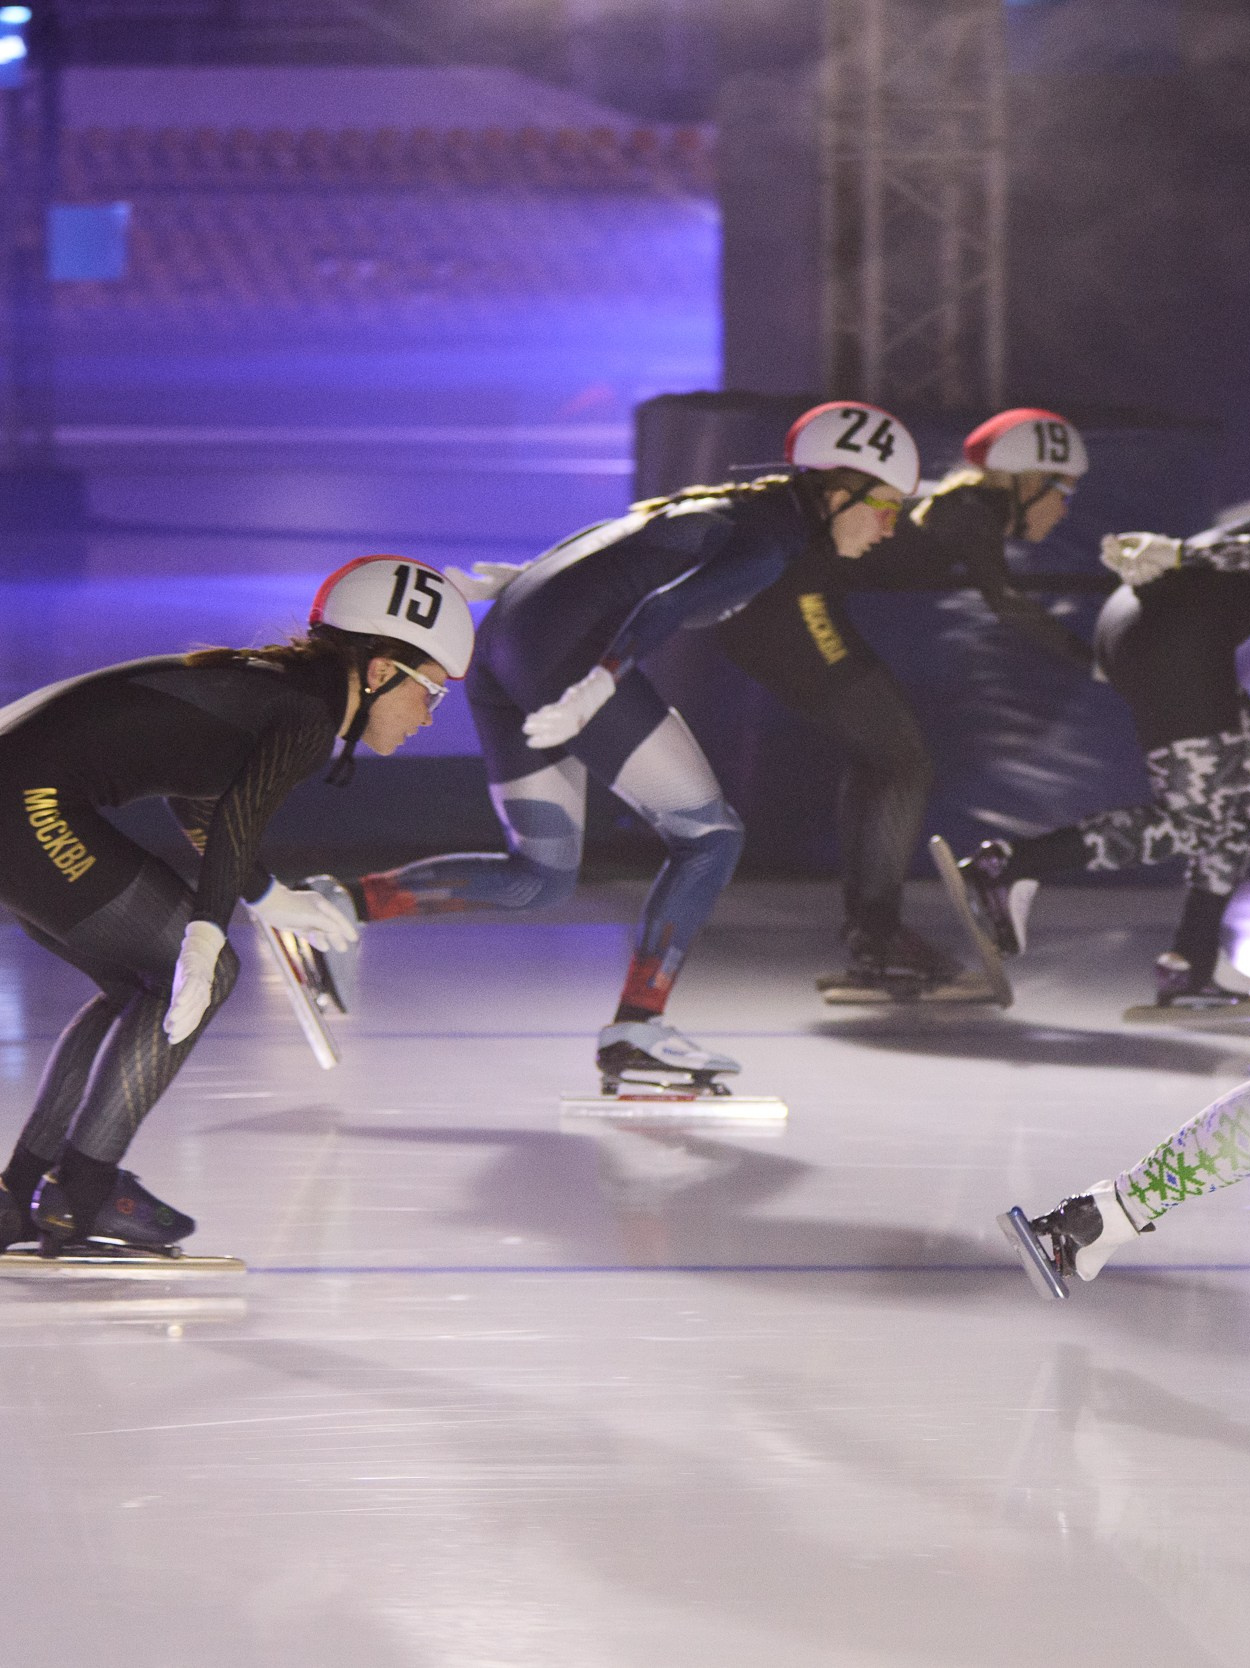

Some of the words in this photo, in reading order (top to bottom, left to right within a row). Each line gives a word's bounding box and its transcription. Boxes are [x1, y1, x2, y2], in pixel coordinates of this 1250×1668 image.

[835, 408, 895, 462] 24
[1033, 420, 1071, 463] 19
[386, 564, 445, 630] 15
[23, 787, 97, 883] МОСКВА
